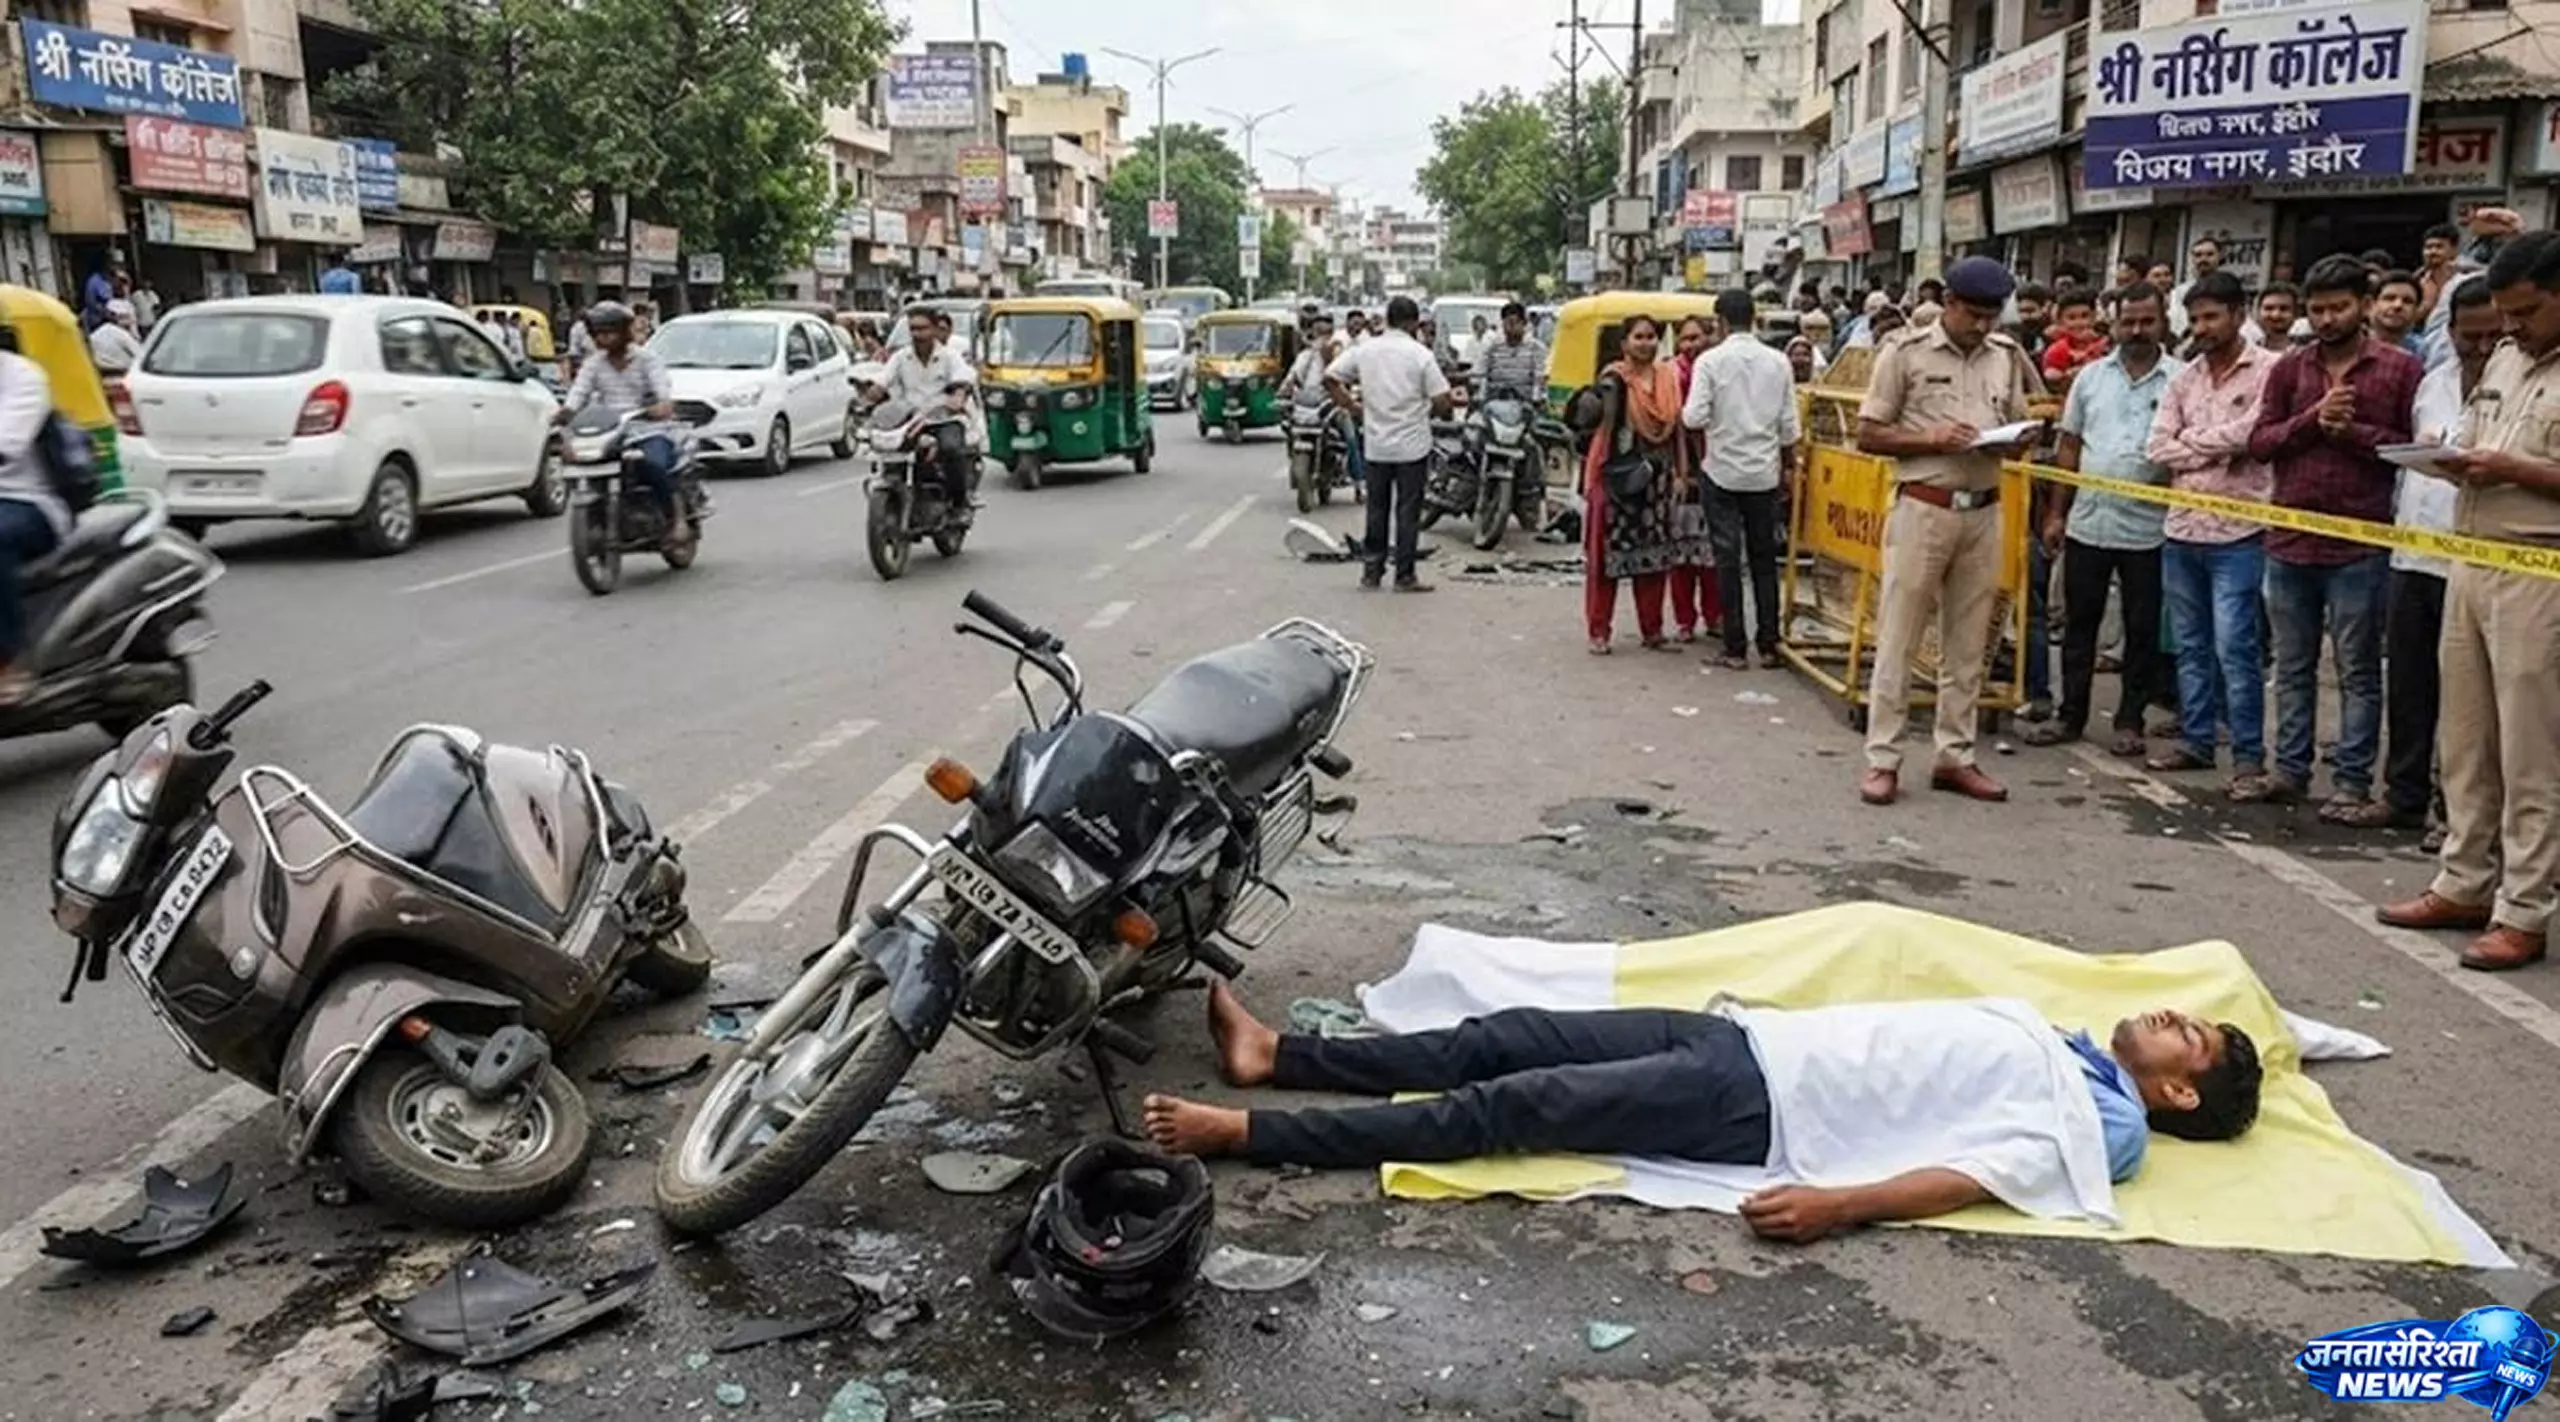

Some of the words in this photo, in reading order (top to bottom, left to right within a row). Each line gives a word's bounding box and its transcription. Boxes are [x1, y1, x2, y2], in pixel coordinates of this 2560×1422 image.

[35, 30, 71, 81] श्री
[2096, 42, 2142, 103] श्री
[2268, 14, 2408, 89] कॉलेज
[2113, 148, 2195, 183] विजय
[2200, 150, 2276, 180] नगर,
[2288, 132, 2366, 178] इंदौर
